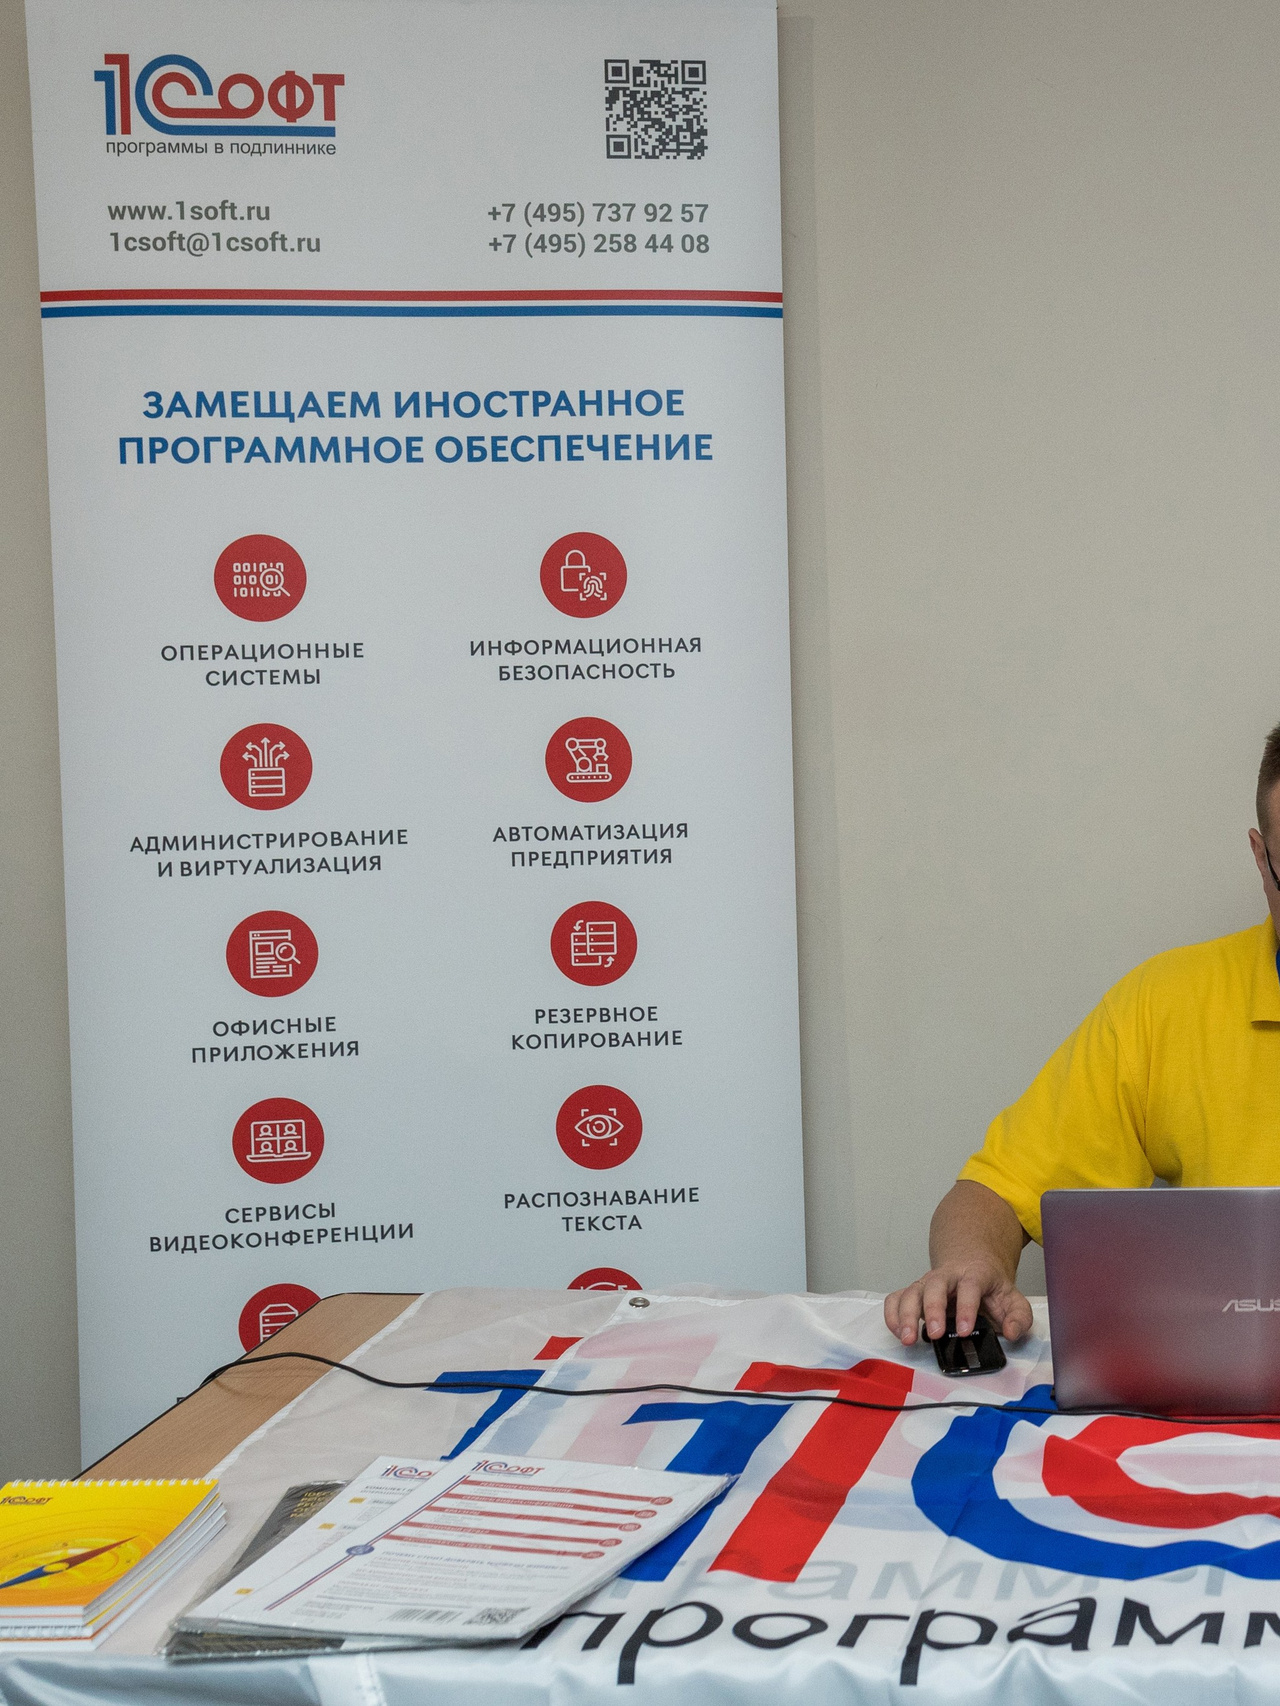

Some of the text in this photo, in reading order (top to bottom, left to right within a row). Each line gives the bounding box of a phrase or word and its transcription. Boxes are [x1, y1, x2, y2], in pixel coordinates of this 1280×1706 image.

[105, 141, 337, 157] программы в подлиннике
[107, 199, 270, 221] www.1soft.ru
[487, 201, 709, 228] +7 (495) 737 92 57
[109, 230, 321, 257] 1csoft@1csoft.ru
[488, 231, 710, 258] +7 (495) 258 44 08
[142, 389, 685, 424] ЗАМЕЩАЕМ ИНОСТРАННОЕ
[118, 433, 713, 465] ПРОГРАММНОЕ ОБЕСПЕЧЕНИЕ
[160, 642, 365, 663] ОПЕРАЦИОННЫЕ
[469, 636, 702, 658] ИНФОРМАЦИОННАЯ
[205, 668, 321, 687] СИСТЕМЫ
[498, 662, 676, 682] БЕЗОПАСНОСТЬ
[129, 828, 409, 854] АДМИНИСТРИРОВАНИЕ
[492, 822, 689, 843] АВТОМАТИЗАЦИЯ
[157, 854, 382, 878] И ВИРТУАЛИЗАЦИЯ
[511, 848, 673, 870] ПРЕДПРИЯТИЯ
[534, 1005, 659, 1025] РЕЗЕРВНОЕ
[212, 1016, 337, 1038] ОФИСНЫЕ
[511, 1029, 683, 1051] КОПИРОВАНИЕ
[191, 1040, 360, 1064] ПРИЛОЖЕНИЯ
[504, 1186, 700, 1210] РАСПОЗНАВАНИЕ
[224, 1202, 336, 1224] СЕРВИСЫ
[561, 1214, 643, 1233] ТЕКСТА
[149, 1222, 414, 1254] ВИДЕОКОНФЕРЕНЦИИ
